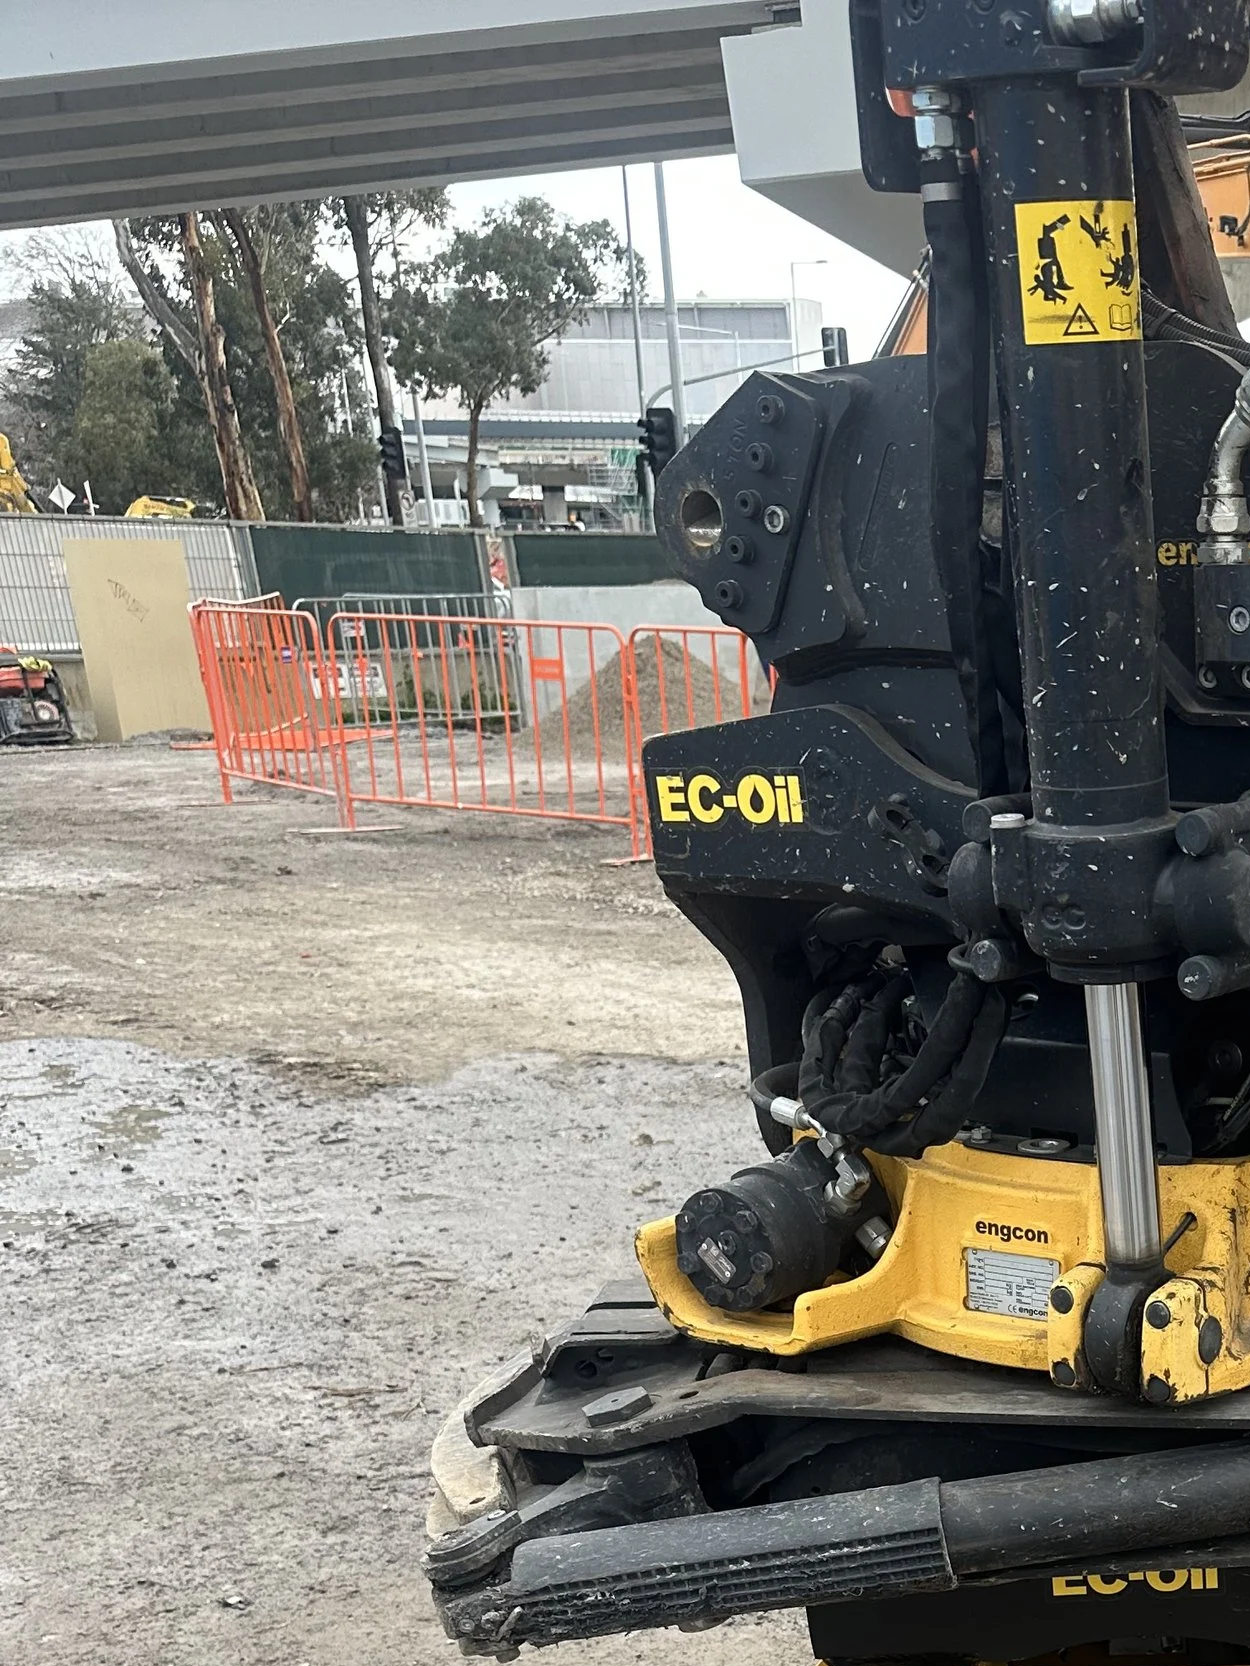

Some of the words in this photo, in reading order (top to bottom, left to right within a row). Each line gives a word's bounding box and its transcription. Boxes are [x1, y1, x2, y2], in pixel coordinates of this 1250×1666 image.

[655, 773, 804, 824] EC-Oil
[975, 1220, 1049, 1244] engcon
[1018, 1306, 1049, 1318] engcon
